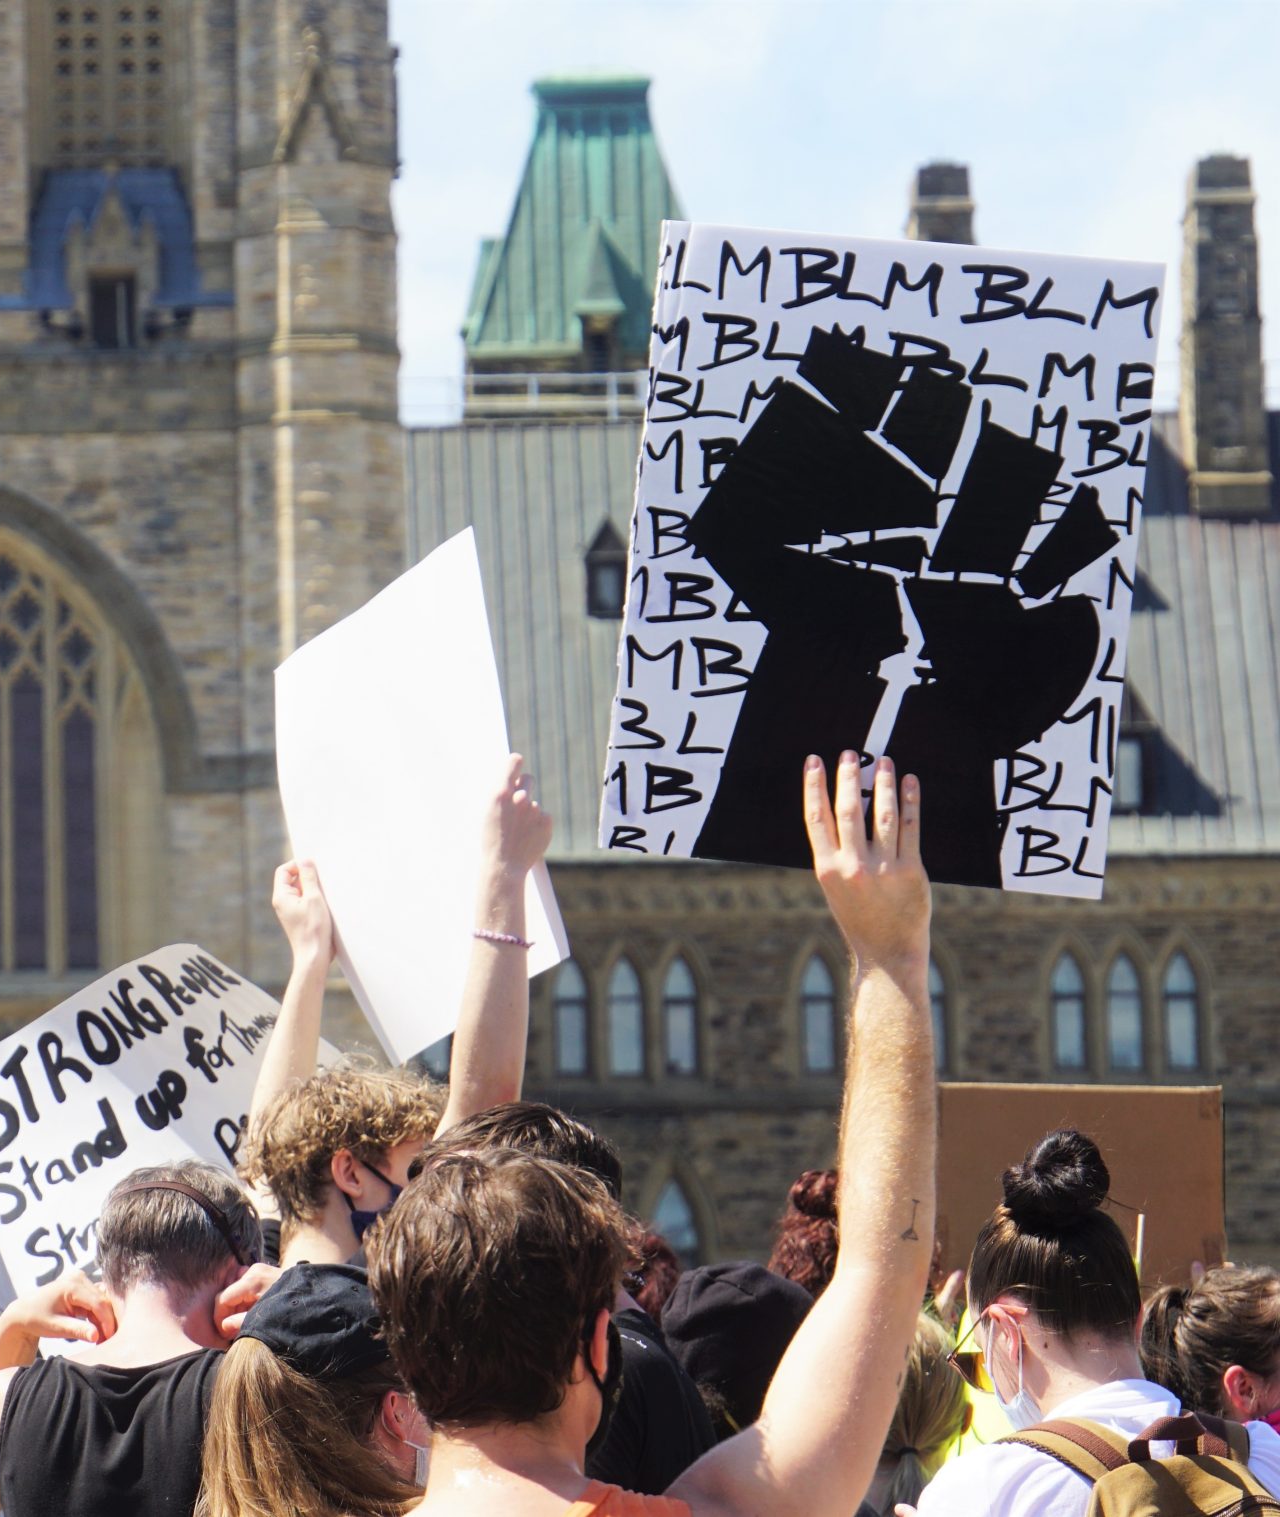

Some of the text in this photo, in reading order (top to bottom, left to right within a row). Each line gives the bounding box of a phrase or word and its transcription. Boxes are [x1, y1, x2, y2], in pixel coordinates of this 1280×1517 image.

[780, 247, 943, 317] BLM
[960, 264, 1159, 339] BLM
[182, 1026, 234, 1084] for
